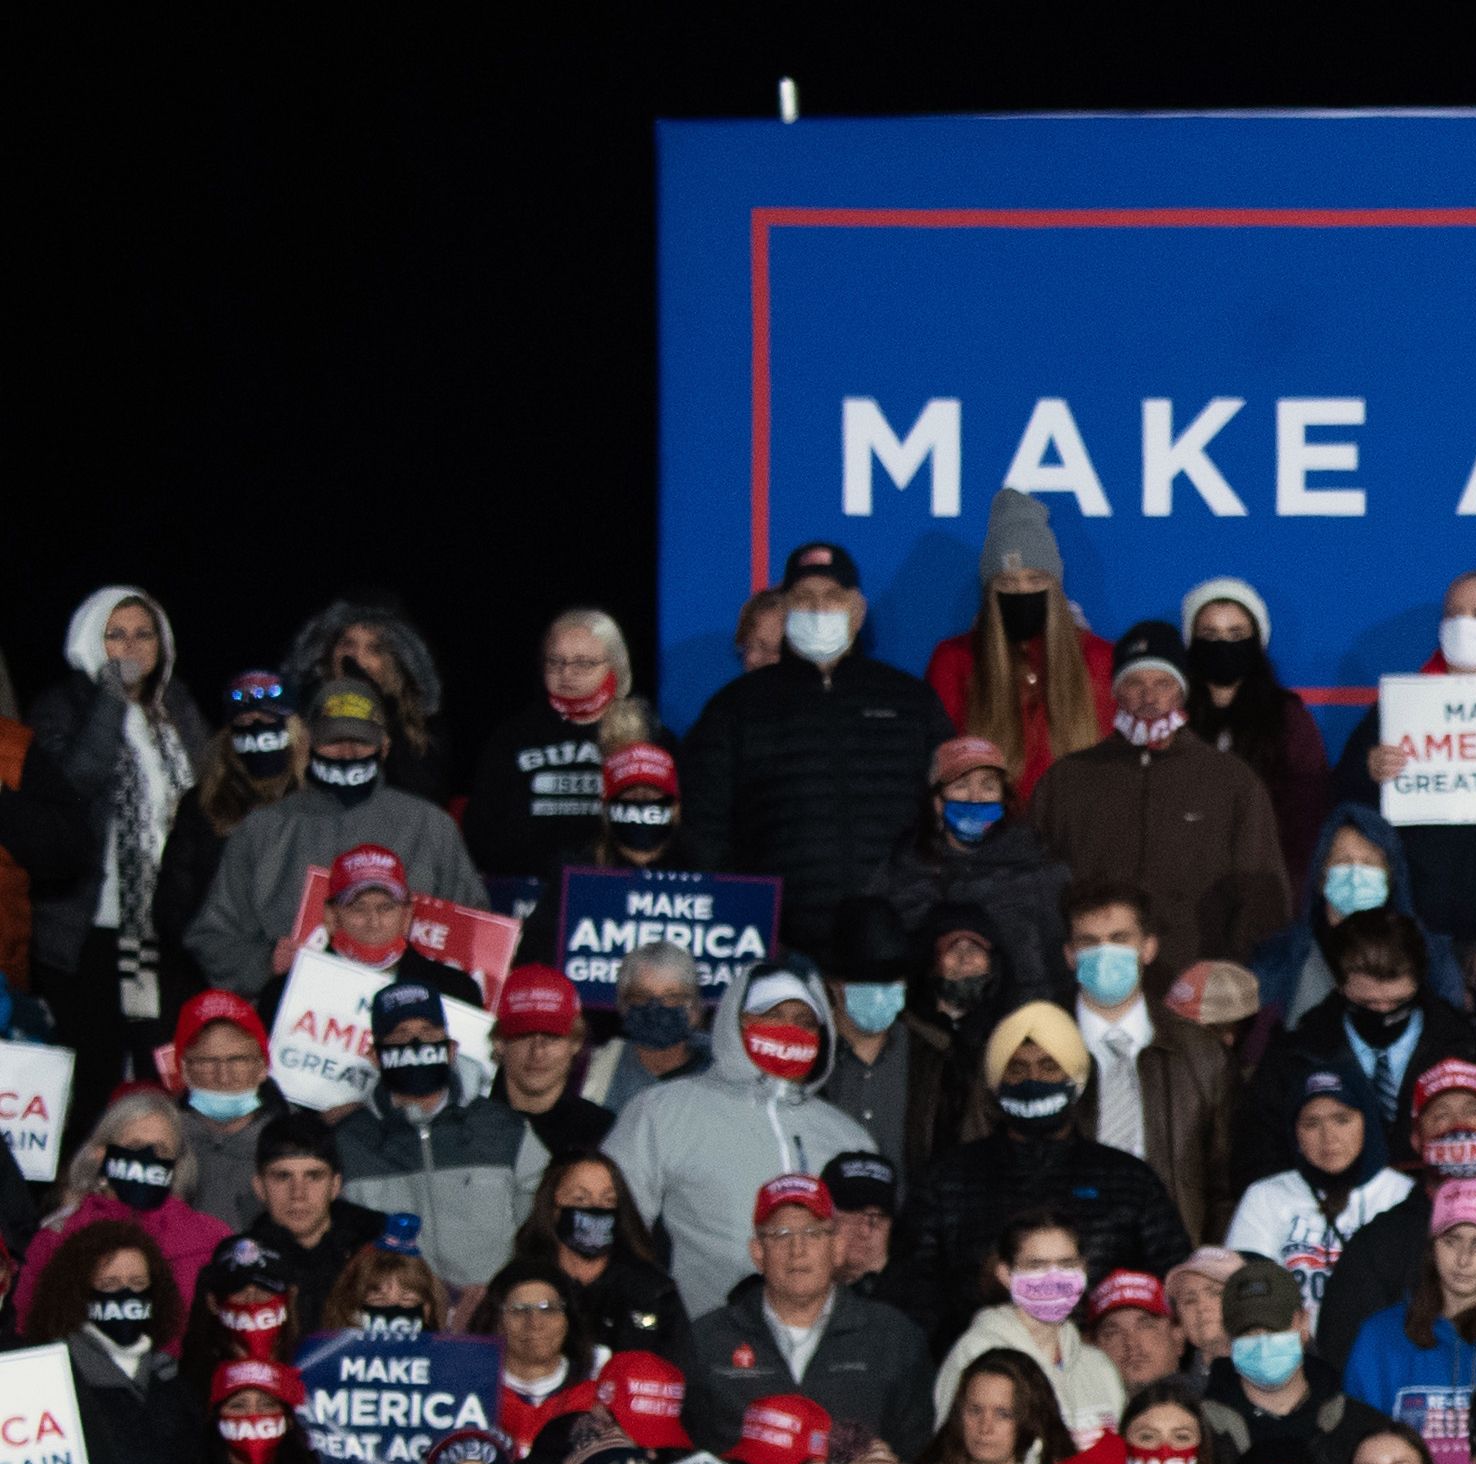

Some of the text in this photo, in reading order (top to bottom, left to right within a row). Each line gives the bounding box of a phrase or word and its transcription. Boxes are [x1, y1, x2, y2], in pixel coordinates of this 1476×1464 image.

[842, 394, 1366, 517] MAKE
[627, 892, 712, 920] MAKE
[568, 920, 765, 958] AMERICA
[750, 1036, 817, 1062] TRUMP
[341, 1357, 429, 1384] MAKE
[312, 1432, 383, 1461] REAT
